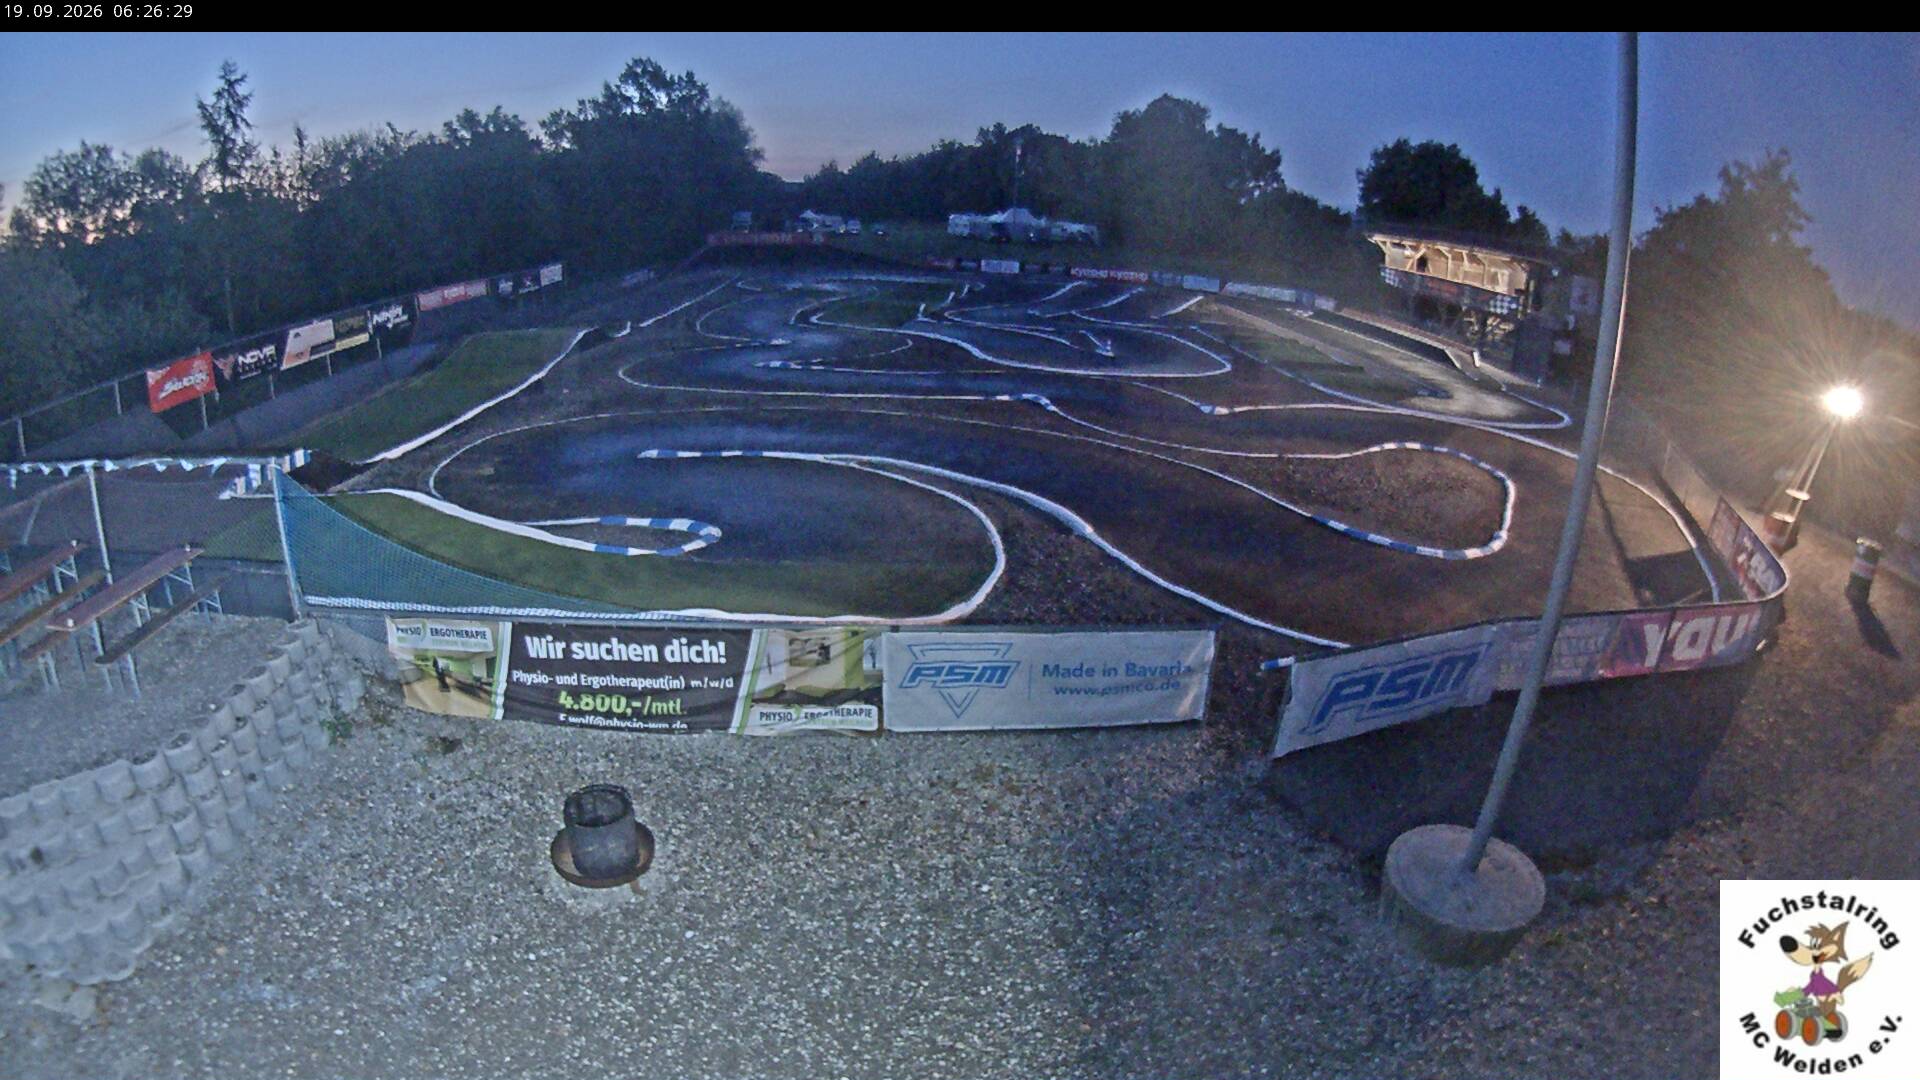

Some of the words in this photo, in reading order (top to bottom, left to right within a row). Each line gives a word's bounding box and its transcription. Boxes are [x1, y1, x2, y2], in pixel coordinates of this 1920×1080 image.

[430, 627, 488, 640] ERGOTHERAPIE
[524, 635, 566, 659] Wir
[571, 637, 659, 662] suchen
[664, 637, 727, 664] dich!
[905, 663, 1013, 686] PSM
[1041, 663, 1096, 679] Made
[1102, 662, 1118, 678] in
[1125, 659, 1192, 678] Bavaria
[512, 670, 554, 686] Physio-
[555, 673, 578, 686] und
[580, 674, 685, 690] Ergotherapeut(in)
[690, 676, 734, 689] m/w/d
[1053, 679, 1181, 697] www.psmco.de
[1309, 649, 1482, 727] PSM
[759, 711, 793, 721] PHYSIO
